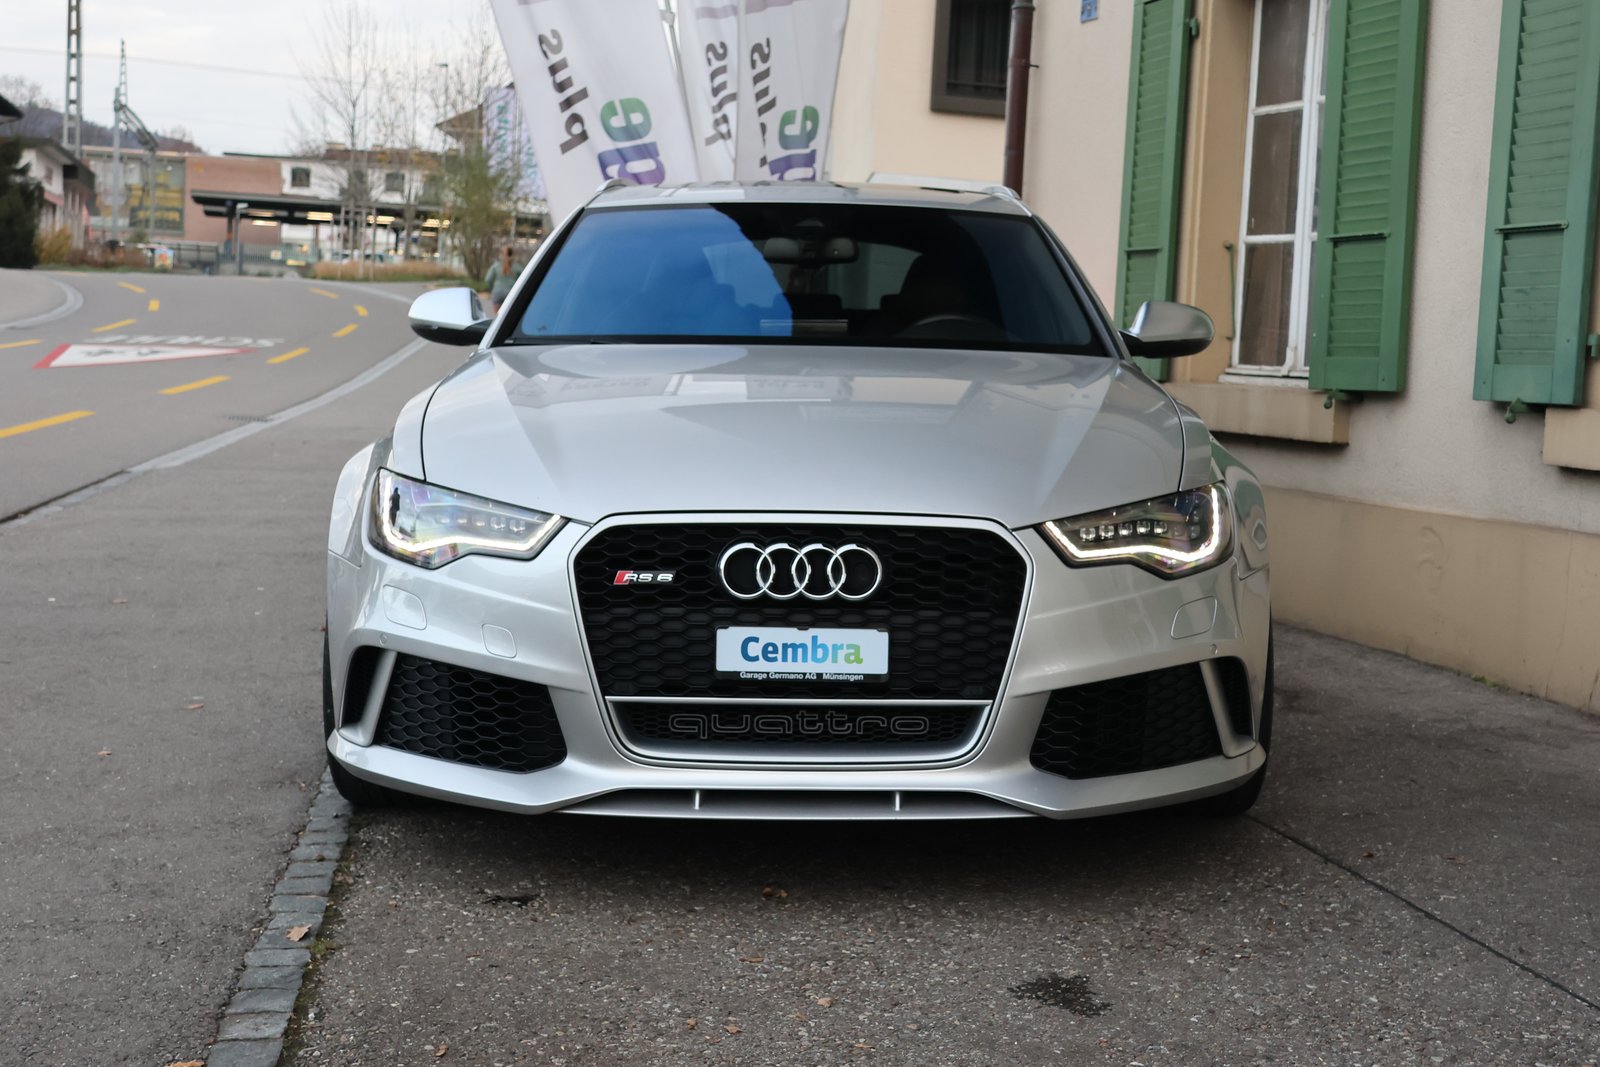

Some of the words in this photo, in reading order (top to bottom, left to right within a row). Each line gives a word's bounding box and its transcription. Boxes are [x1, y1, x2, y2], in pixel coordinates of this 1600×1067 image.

[740, 635, 864, 665] Cembra
[740, 671, 768, 680] Garage
[769, 672, 803, 680] Germano
[804, 672, 817, 680] AG
[822, 672, 864, 682] Münsingen
[668, 711, 929, 740] quattro
